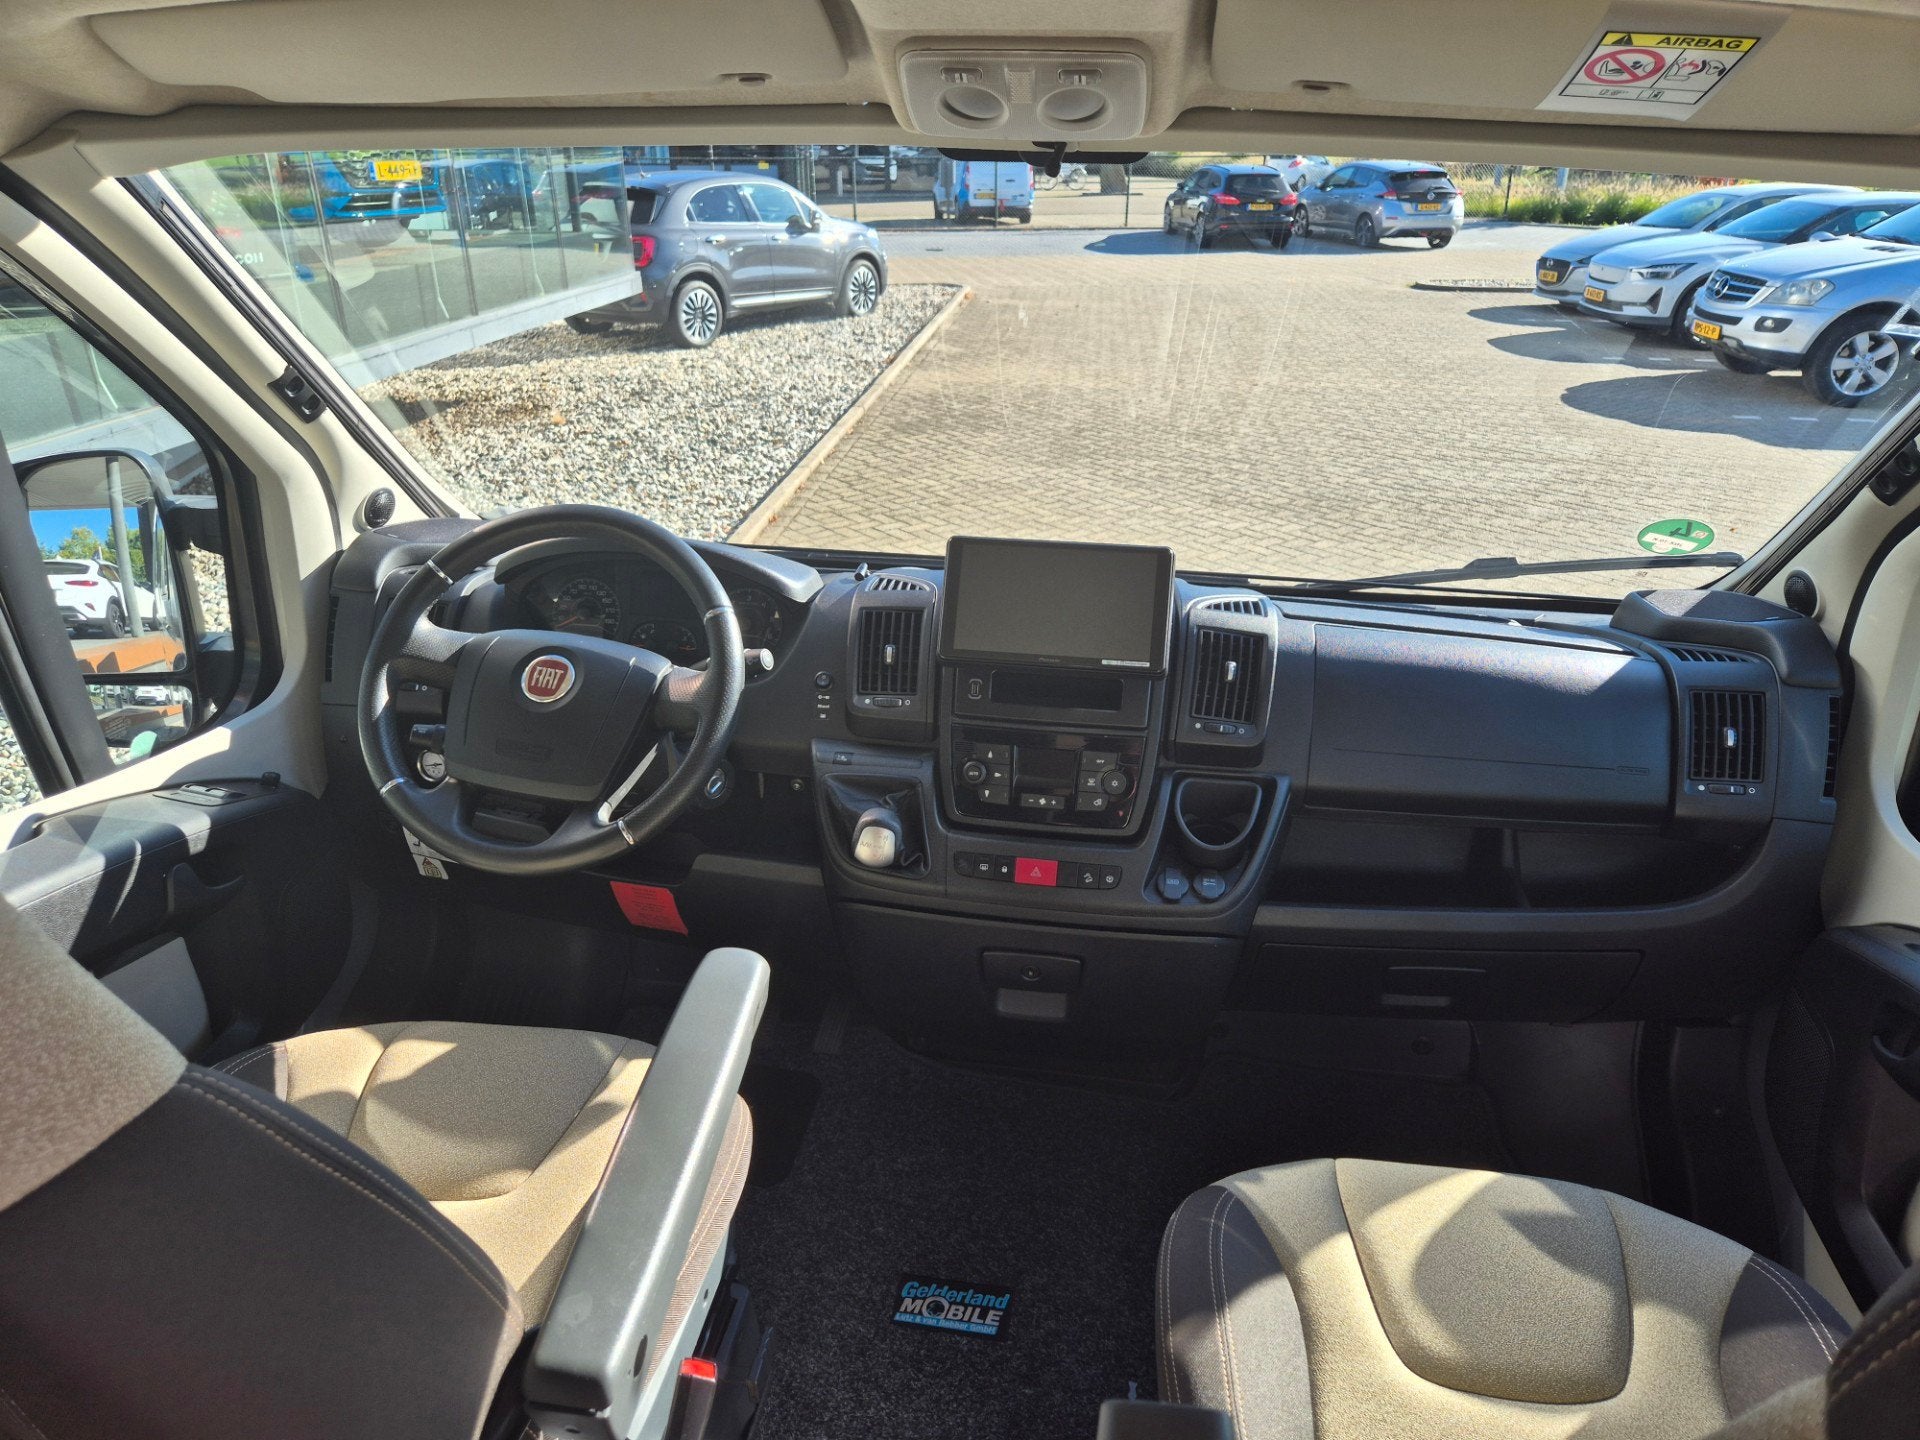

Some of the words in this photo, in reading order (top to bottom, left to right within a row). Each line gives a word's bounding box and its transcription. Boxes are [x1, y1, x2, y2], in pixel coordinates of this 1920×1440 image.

[1656, 36, 1744, 50] AIRBAG
[530, 665, 565, 690] FIAT
[901, 1281, 1011, 1310] Gelderland
[900, 1296, 1004, 1327] MOBILE
